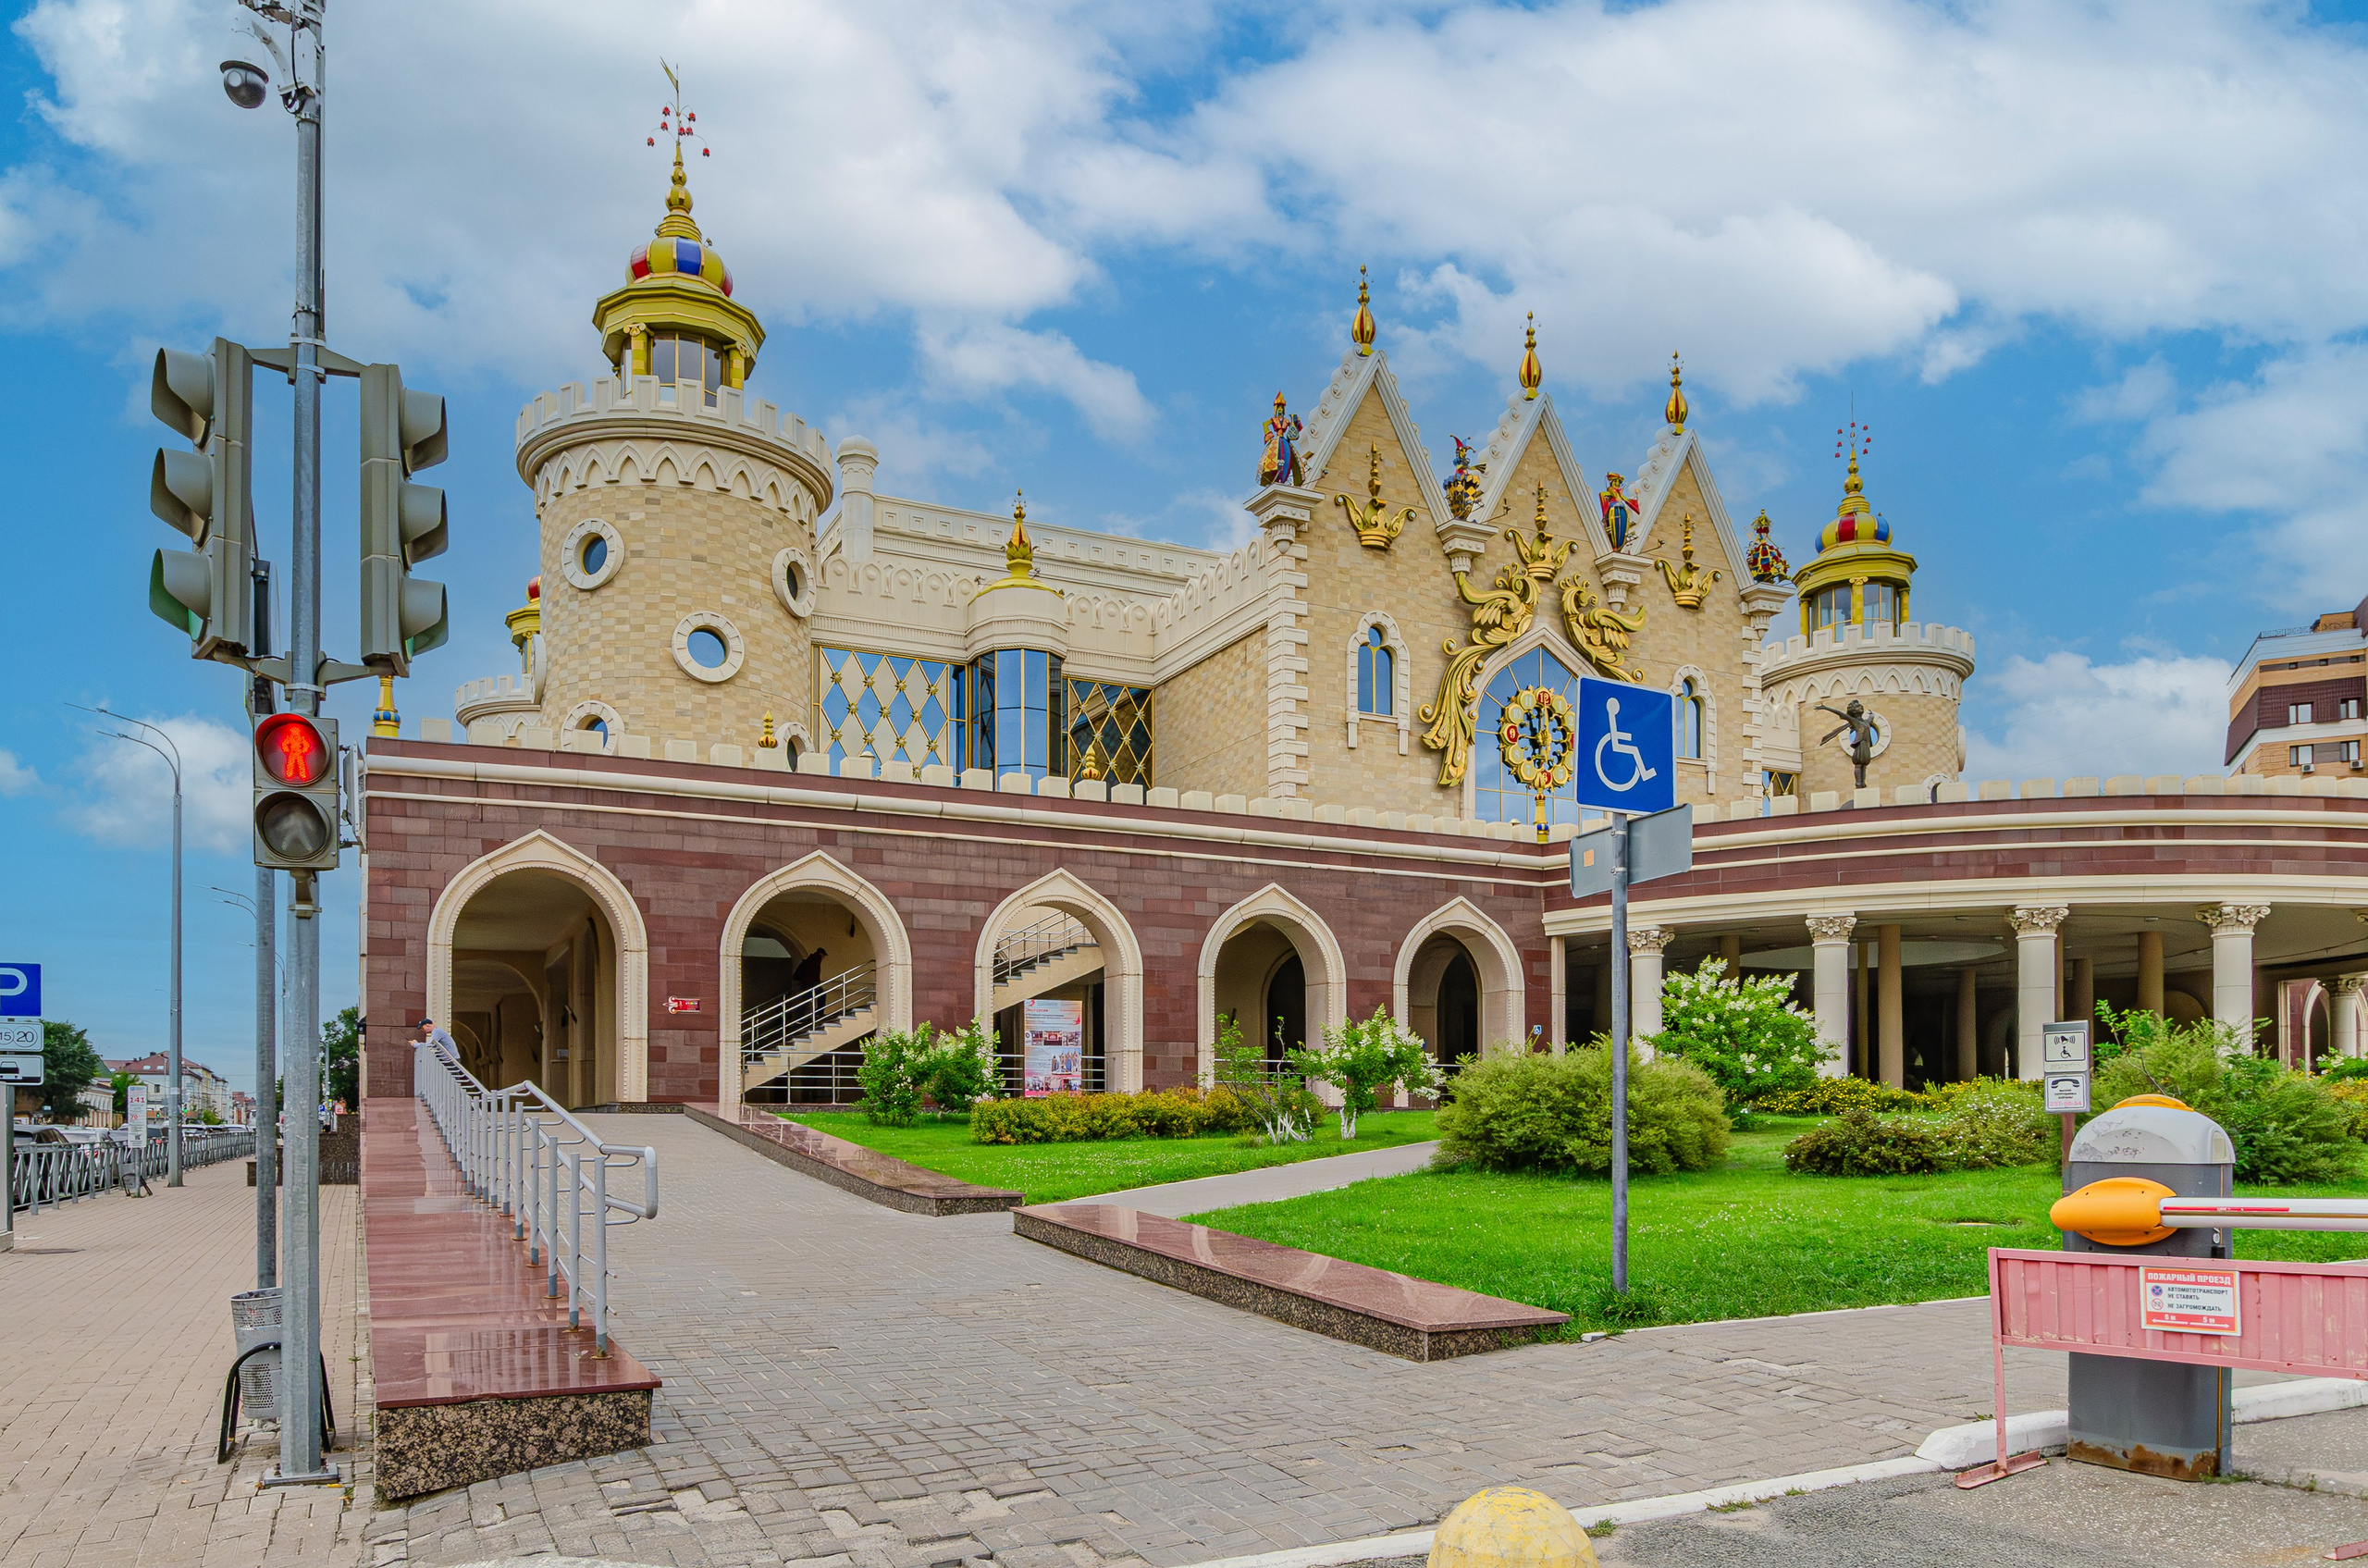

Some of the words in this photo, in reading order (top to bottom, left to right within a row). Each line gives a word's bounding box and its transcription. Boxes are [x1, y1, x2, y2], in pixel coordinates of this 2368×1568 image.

[1539, 692, 1549, 701] 12
[1524, 697, 1532, 706] 11
[1512, 709, 1522, 718] 10
[1510, 728, 1514, 737] 9
[1559, 770, 1563, 780] 5
[17, 1031, 34, 1043] 20
[2148, 1273, 2195, 1282] ПОЖАРНЫЙ
[2198, 1276, 2231, 1285] ПРОЕЗД
[2168, 1287, 2227, 1295] АВТОМОТОТРАНСПОРТ
[2176, 1303, 2222, 1312] ЗАГРОМОЖДАТЬ
